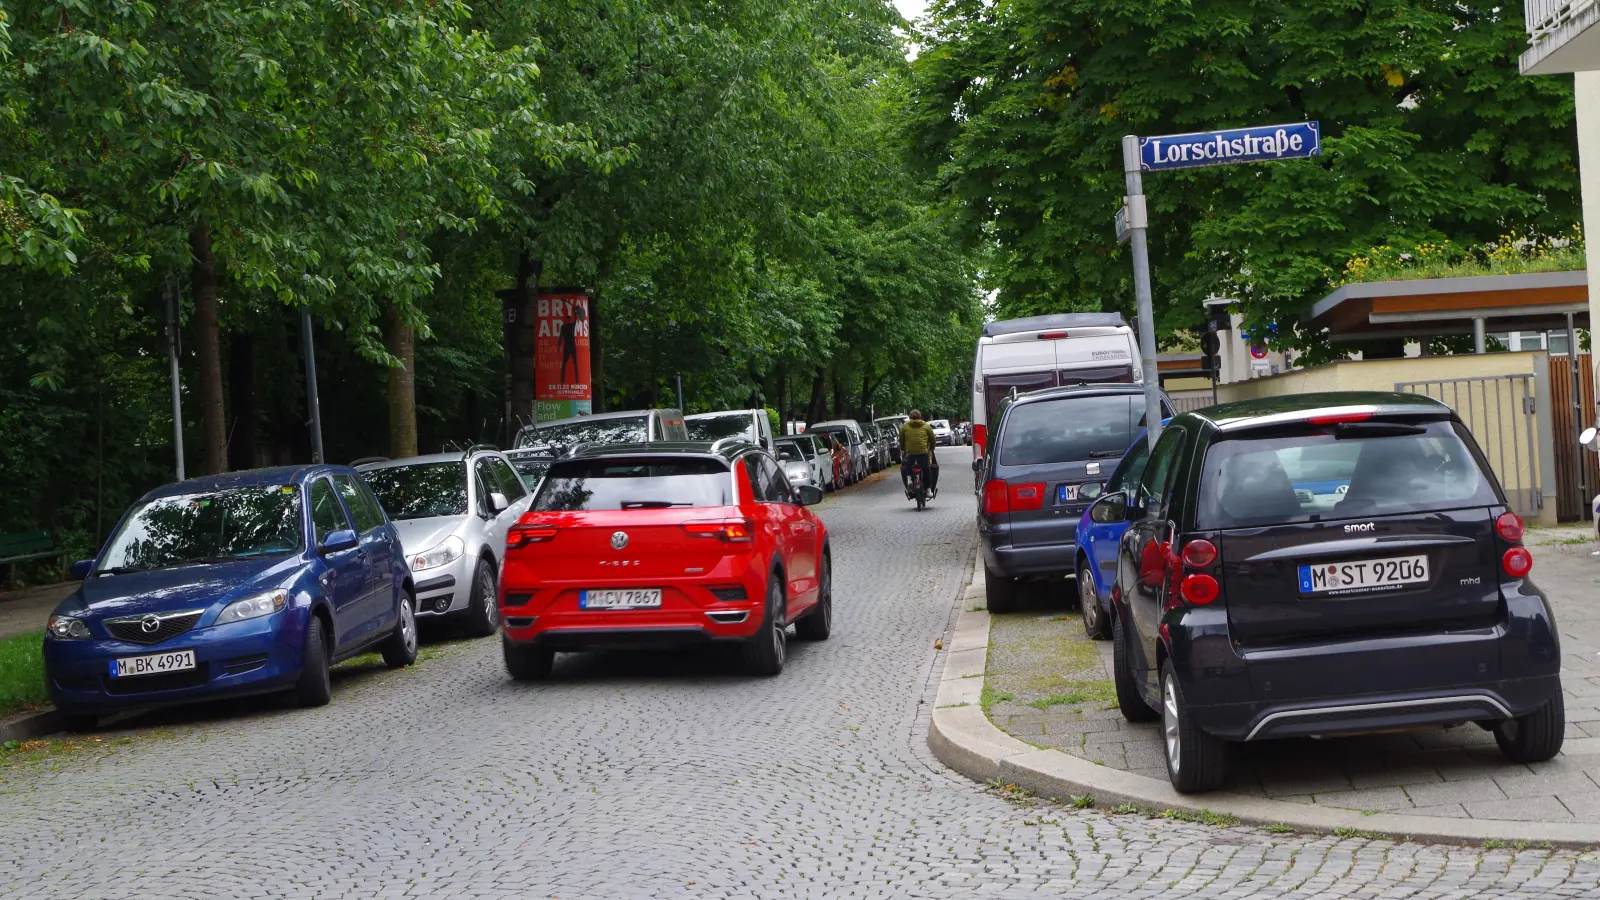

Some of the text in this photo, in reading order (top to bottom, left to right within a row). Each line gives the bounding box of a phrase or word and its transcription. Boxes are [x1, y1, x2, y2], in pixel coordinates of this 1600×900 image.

[1153, 129, 1303, 163] Lorschstraße
[538, 319, 588, 337] ADMS
[537, 401, 562, 410] Flow
[537, 411, 557, 420] and
[1344, 521, 1375, 533] smart
[1372, 558, 1425, 583] 9206
[1460, 576, 1481, 585] mhd
[626, 590, 659, 604] 7867
[136, 657, 154, 672] BK
[157, 652, 193, 670] 4991
